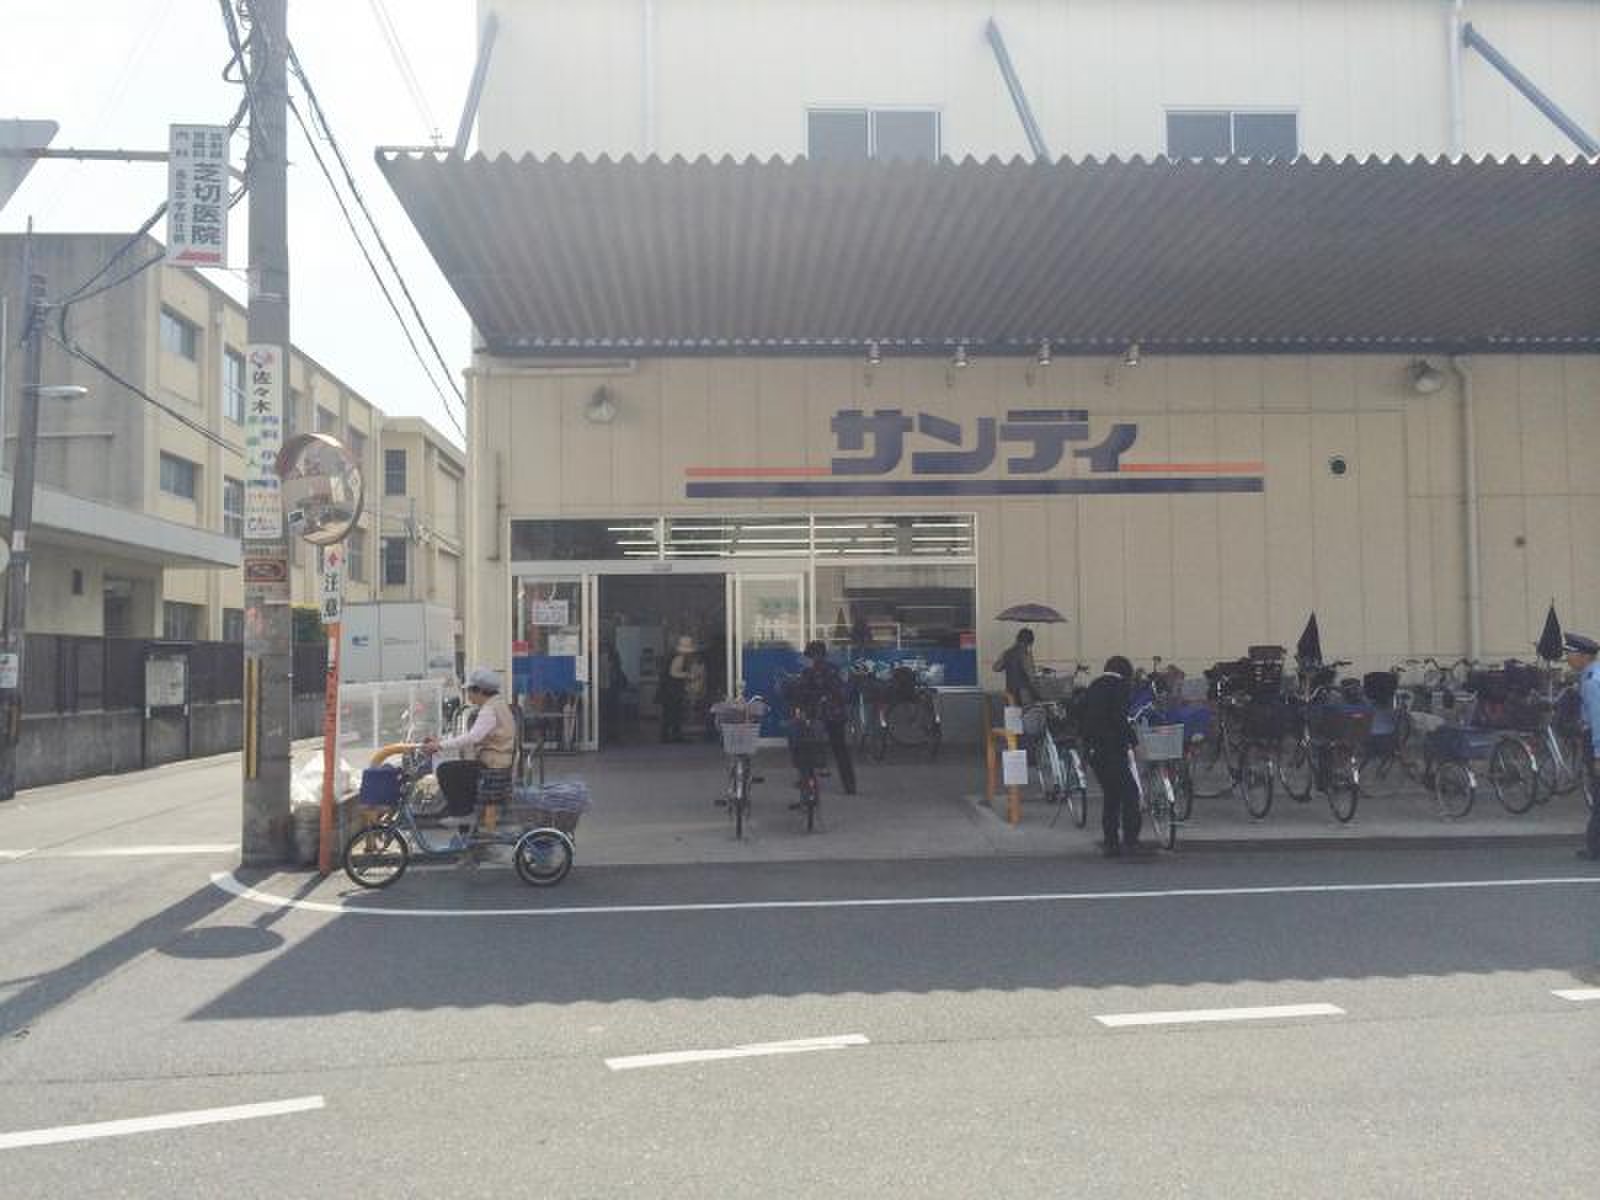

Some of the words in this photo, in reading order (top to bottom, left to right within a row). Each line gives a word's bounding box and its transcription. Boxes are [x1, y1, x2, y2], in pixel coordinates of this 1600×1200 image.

[192, 162, 222, 246] 芝切医院
[252, 370, 273, 414] 佐々木
[830, 408, 1138, 476] サンディ
